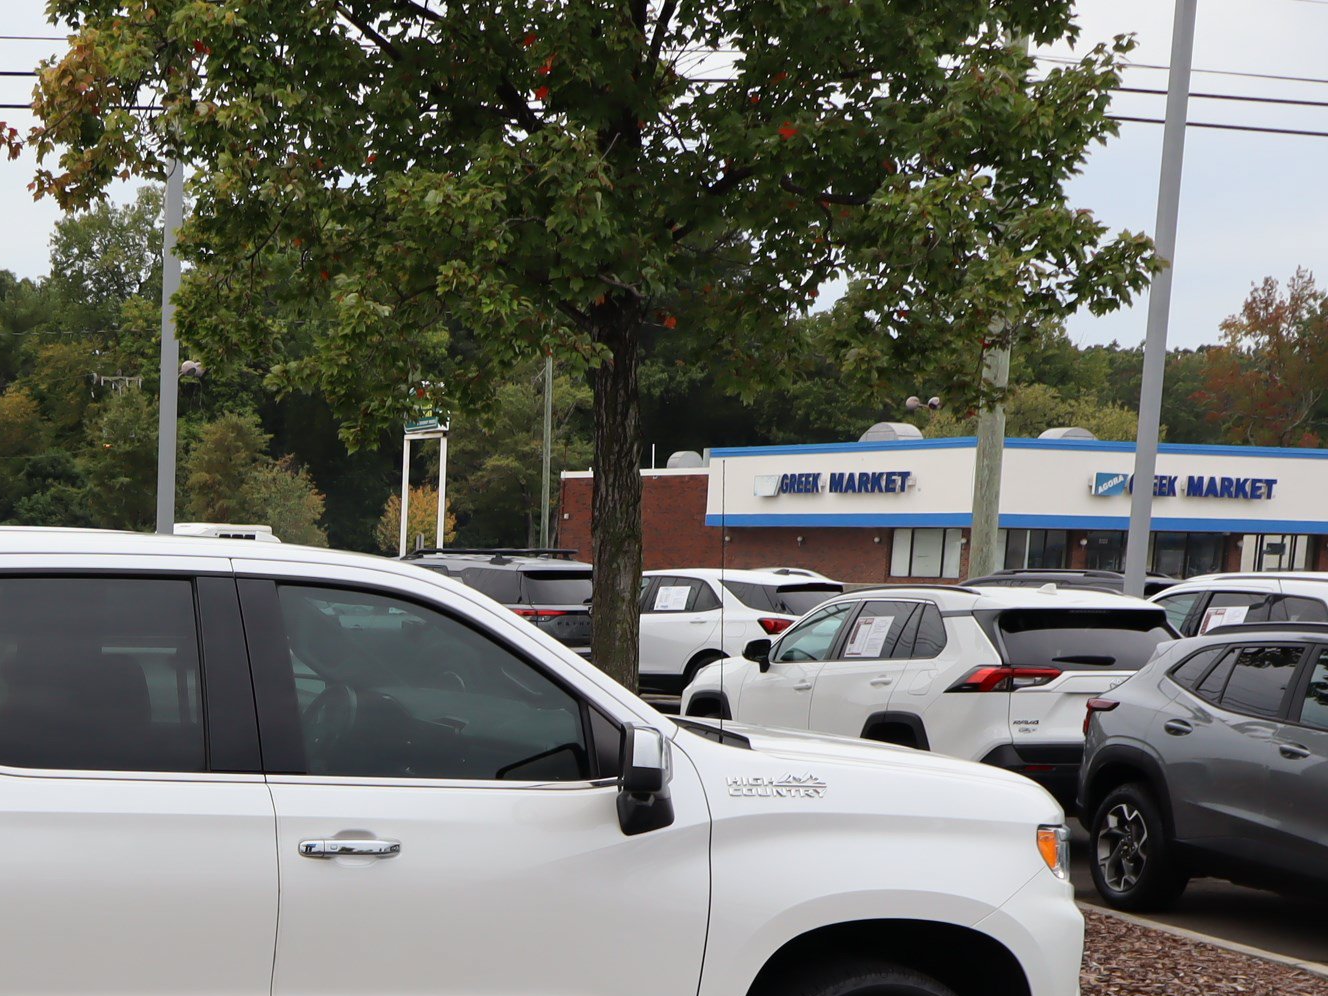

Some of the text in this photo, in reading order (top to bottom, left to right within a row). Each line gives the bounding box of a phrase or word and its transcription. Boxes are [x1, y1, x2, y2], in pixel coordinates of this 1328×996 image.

[780, 471, 911, 494] GREEK MARKET
[1097, 474, 1125, 495] AGORA
[1185, 475, 1278, 500] MARKET
[725, 776, 776, 787] HIGH
[728, 786, 827, 799] COUNTRY
